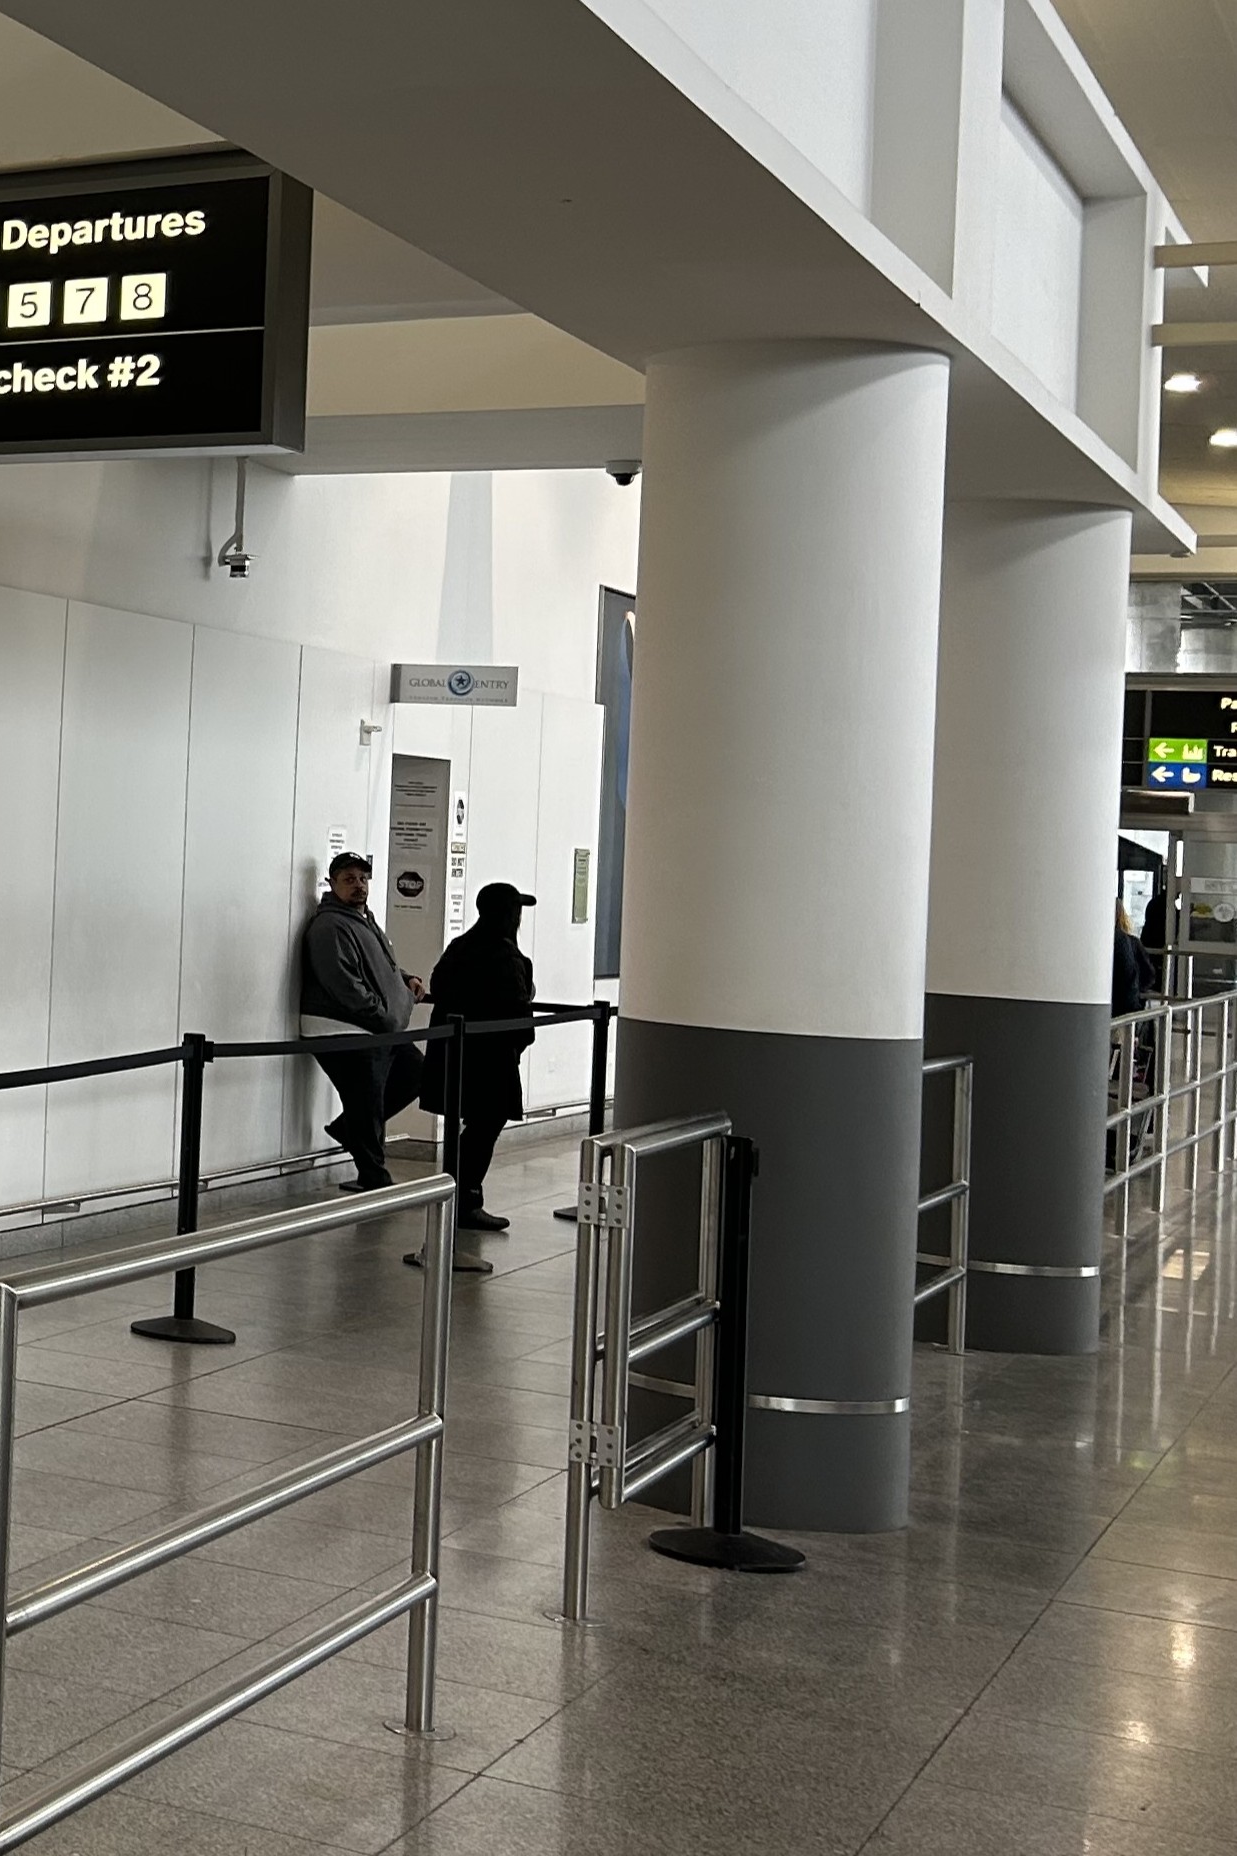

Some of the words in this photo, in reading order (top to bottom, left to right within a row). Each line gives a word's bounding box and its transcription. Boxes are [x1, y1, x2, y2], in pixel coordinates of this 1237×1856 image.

[1, 208, 207, 255] Departures
[18, 290, 39, 319] 5
[74, 286, 96, 316] 7
[132, 282, 154, 311] 8
[107, 353, 162, 388] #2
[408, 677, 447, 688] GLOBAL
[473, 679, 510, 690] ENTRY
[398, 880, 423, 890] STOP
